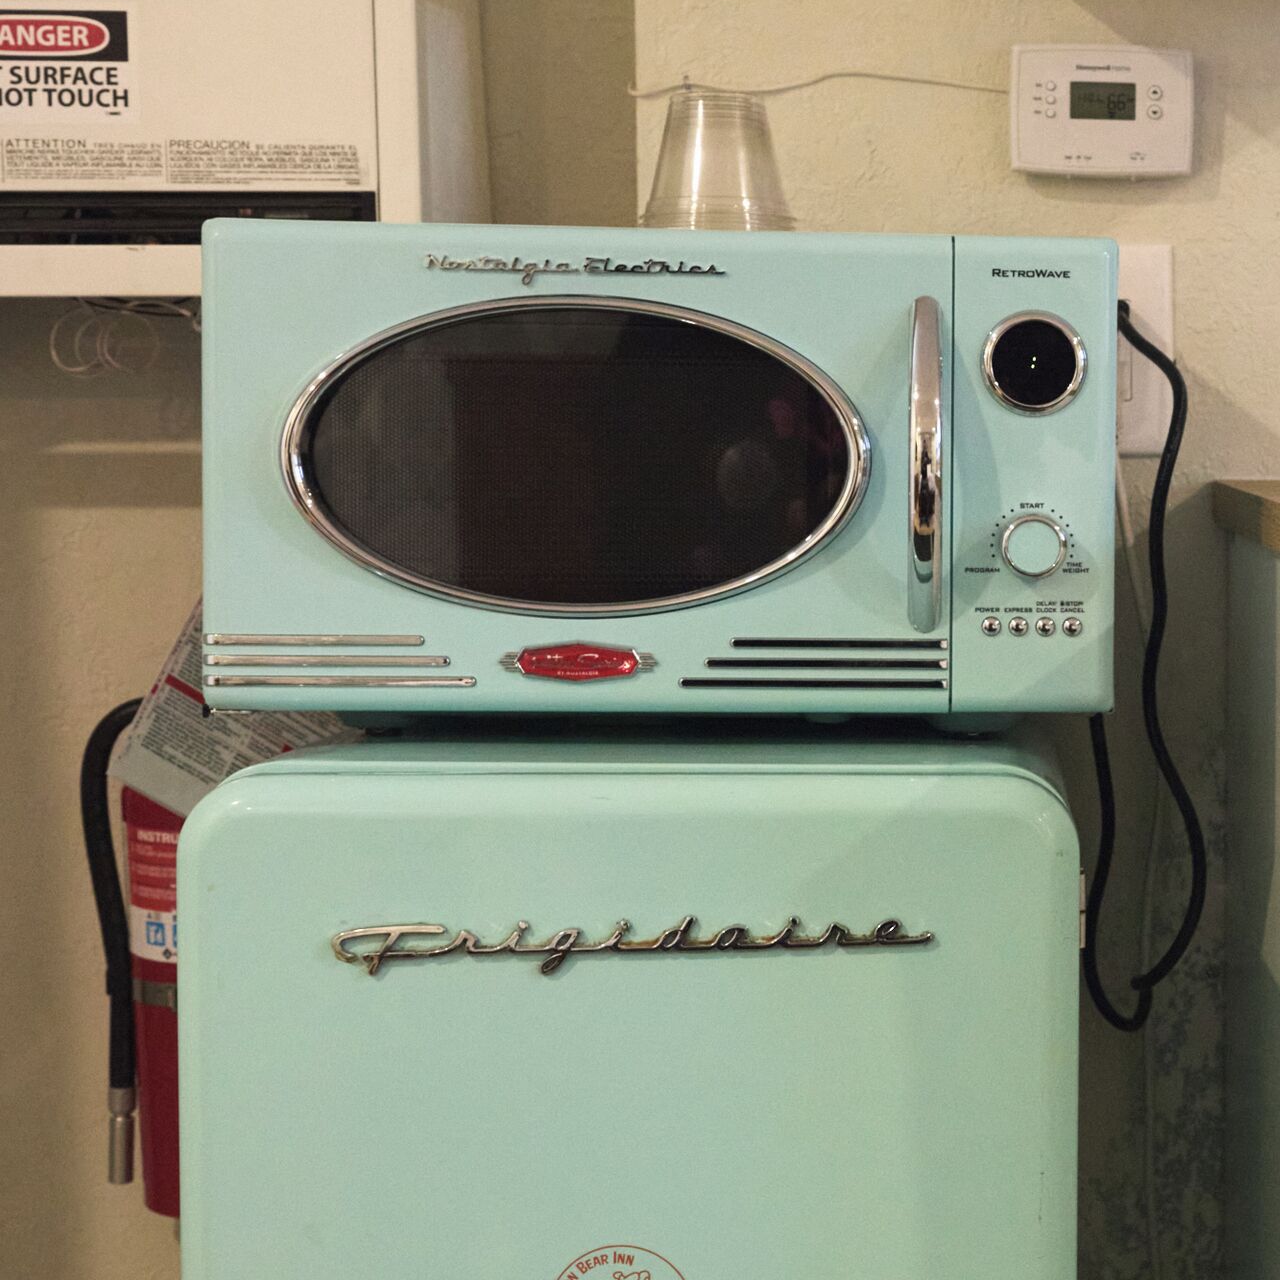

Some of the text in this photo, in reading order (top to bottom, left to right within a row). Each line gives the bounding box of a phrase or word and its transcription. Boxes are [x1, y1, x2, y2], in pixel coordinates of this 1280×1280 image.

[9, 65, 119, 85] SURFACE
[0, 87, 128, 107] OT TOUCH
[6, 138, 87, 149] ATTENTION
[169, 139, 250, 149] PRECAUCION
[425, 253, 727, 286] Nostalgia Electrics
[330, 914, 935, 976] Frigidaire
[575, 1253, 610, 1275] BEAR
[612, 1251, 636, 1267] INN
